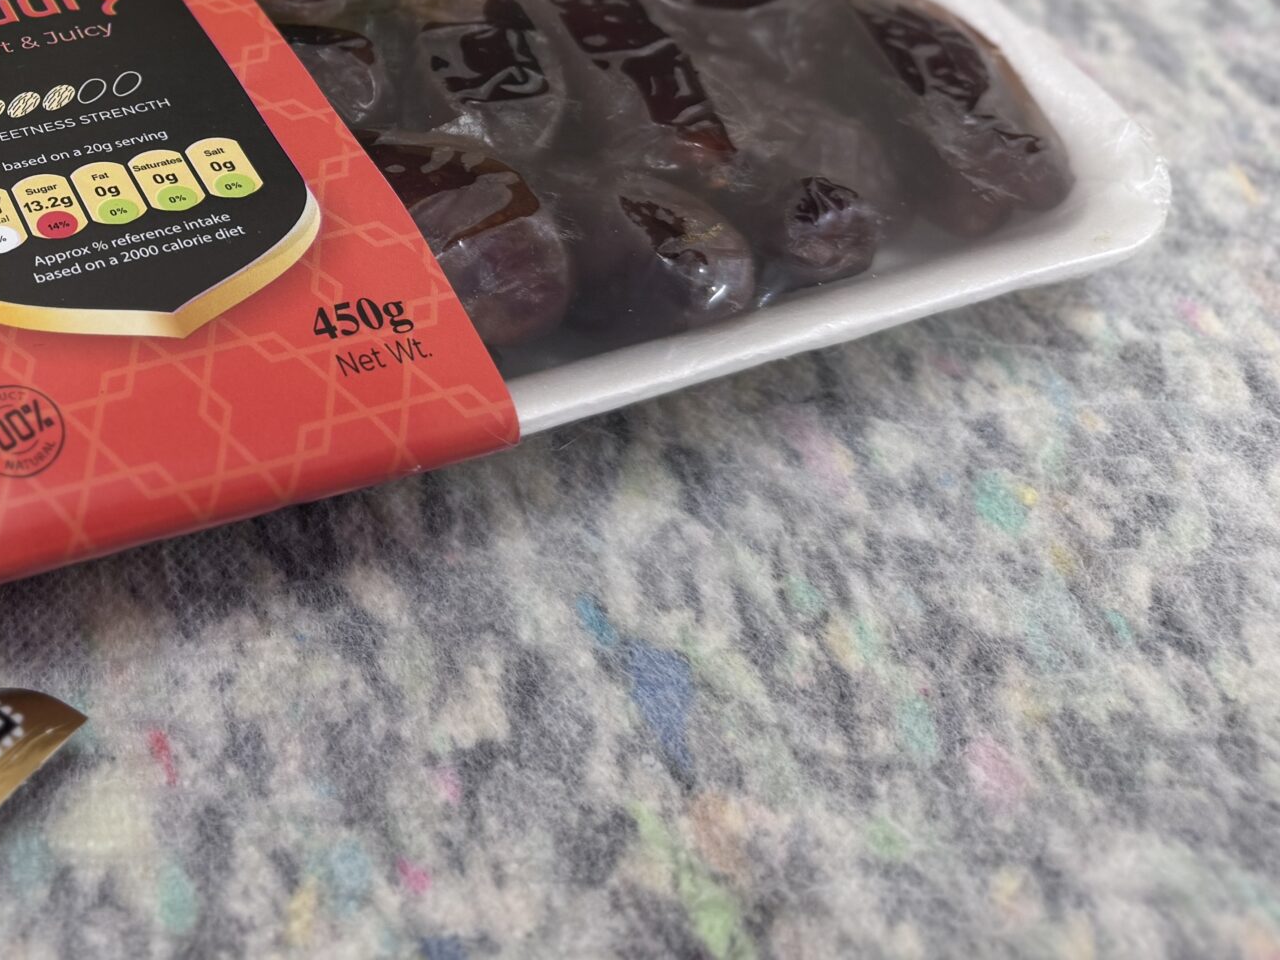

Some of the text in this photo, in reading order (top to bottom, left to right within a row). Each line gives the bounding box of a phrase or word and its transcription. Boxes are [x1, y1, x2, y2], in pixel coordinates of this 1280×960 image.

[20, 34, 41, 50] &
[42, 22, 113, 45] Juicy
[79, 98, 172, 125] STRENGTH
[2, 129, 169, 172] based on a 20g serving
[203, 147, 225, 157] Salt
[132, 156, 183, 172] Saturates
[209, 158, 236, 172] 0g
[91, 172, 110, 181] Fat
[152, 171, 179, 185] 0g
[25, 183, 58, 196] Sugar
[94, 184, 121, 198] 0g
[224, 181, 242, 191] 0%
[23, 195, 74, 214] 13.2g
[168, 194, 187, 204] 0%
[109, 207, 128, 217] 0%
[47, 220, 70, 231] 14%
[34, 213, 231, 267] Approx % reference intake
[33, 224, 246, 284] based on a 2000 calorie diet
[312, 297, 415, 339] 450g
[334, 336, 434, 378] Net Wt.
[4, 441, 57, 470] NATURAL
